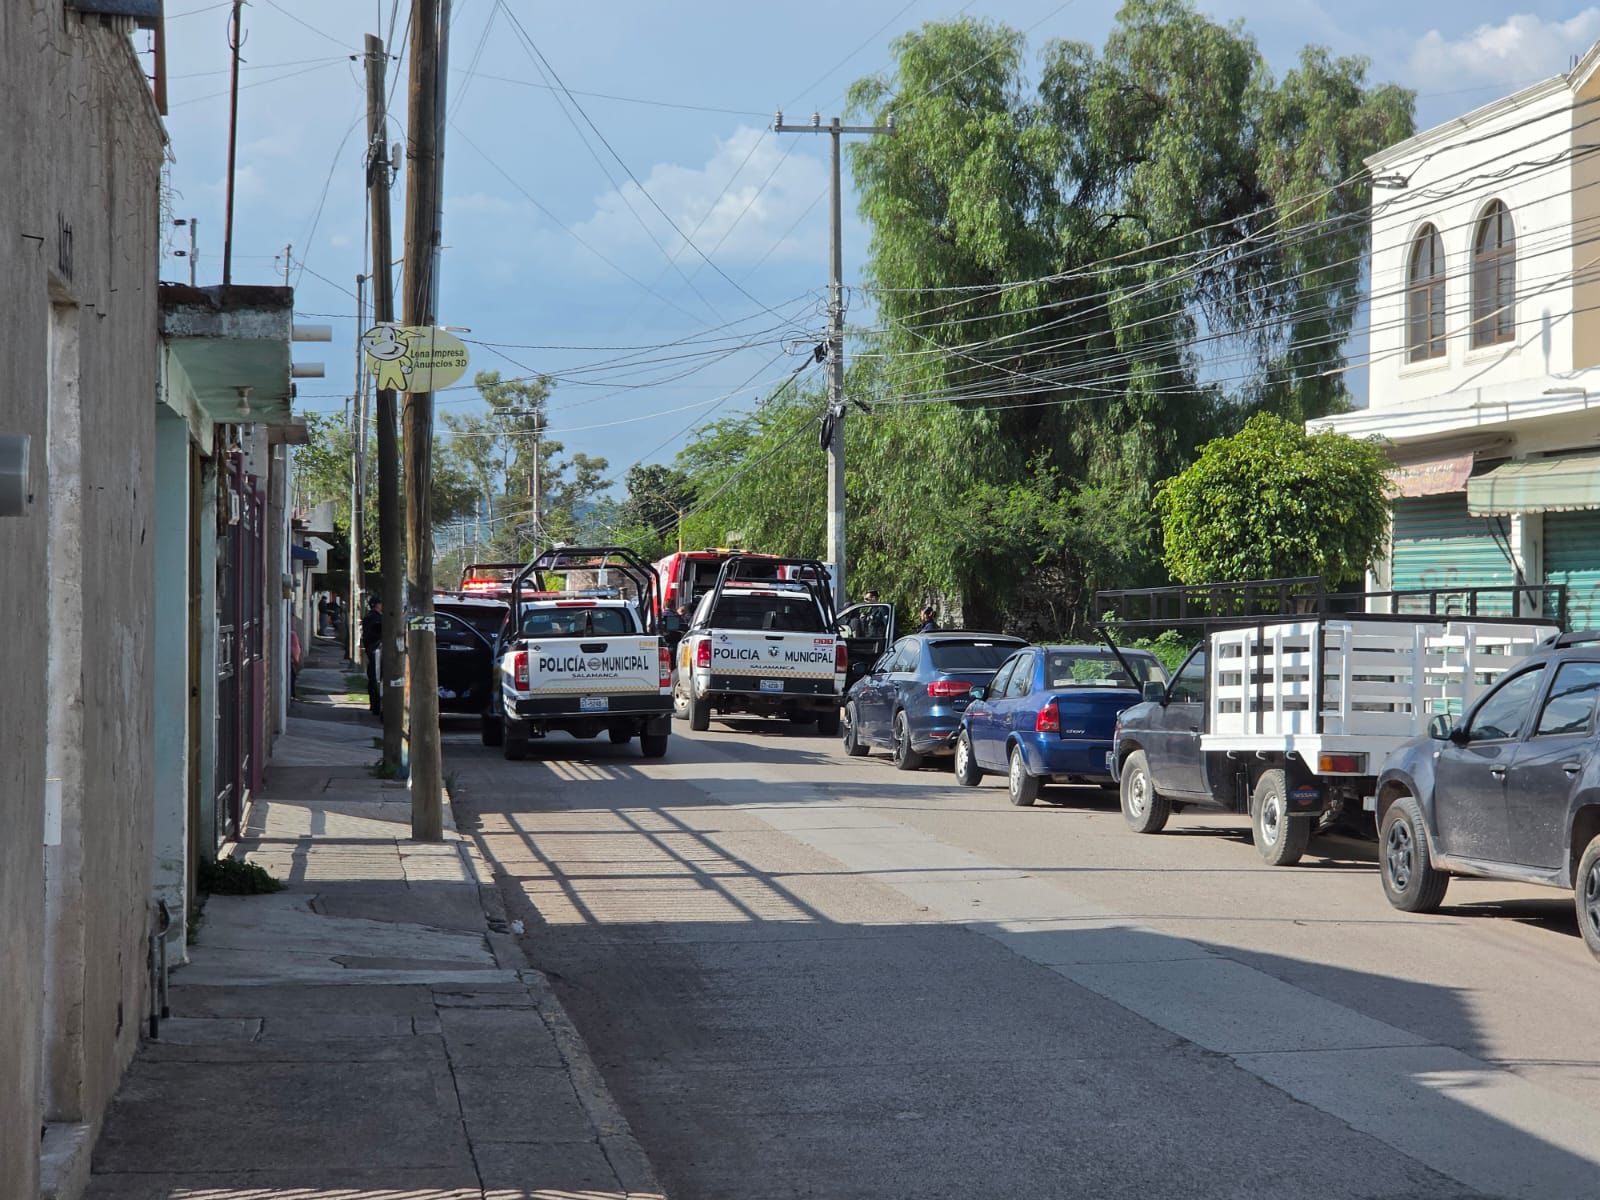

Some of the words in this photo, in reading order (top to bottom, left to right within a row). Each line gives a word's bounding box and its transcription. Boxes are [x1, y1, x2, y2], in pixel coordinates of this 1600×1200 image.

[410, 350, 429, 358] Lona
[414, 360, 453, 368] Anuncios
[455, 359, 467, 367] 3D
[713, 648, 759, 660] POLICÍA
[784, 651, 833, 664] MUNICIPAL
[539, 655, 586, 672] POLICÍA
[602, 655, 649, 671] MUNICIPAL
